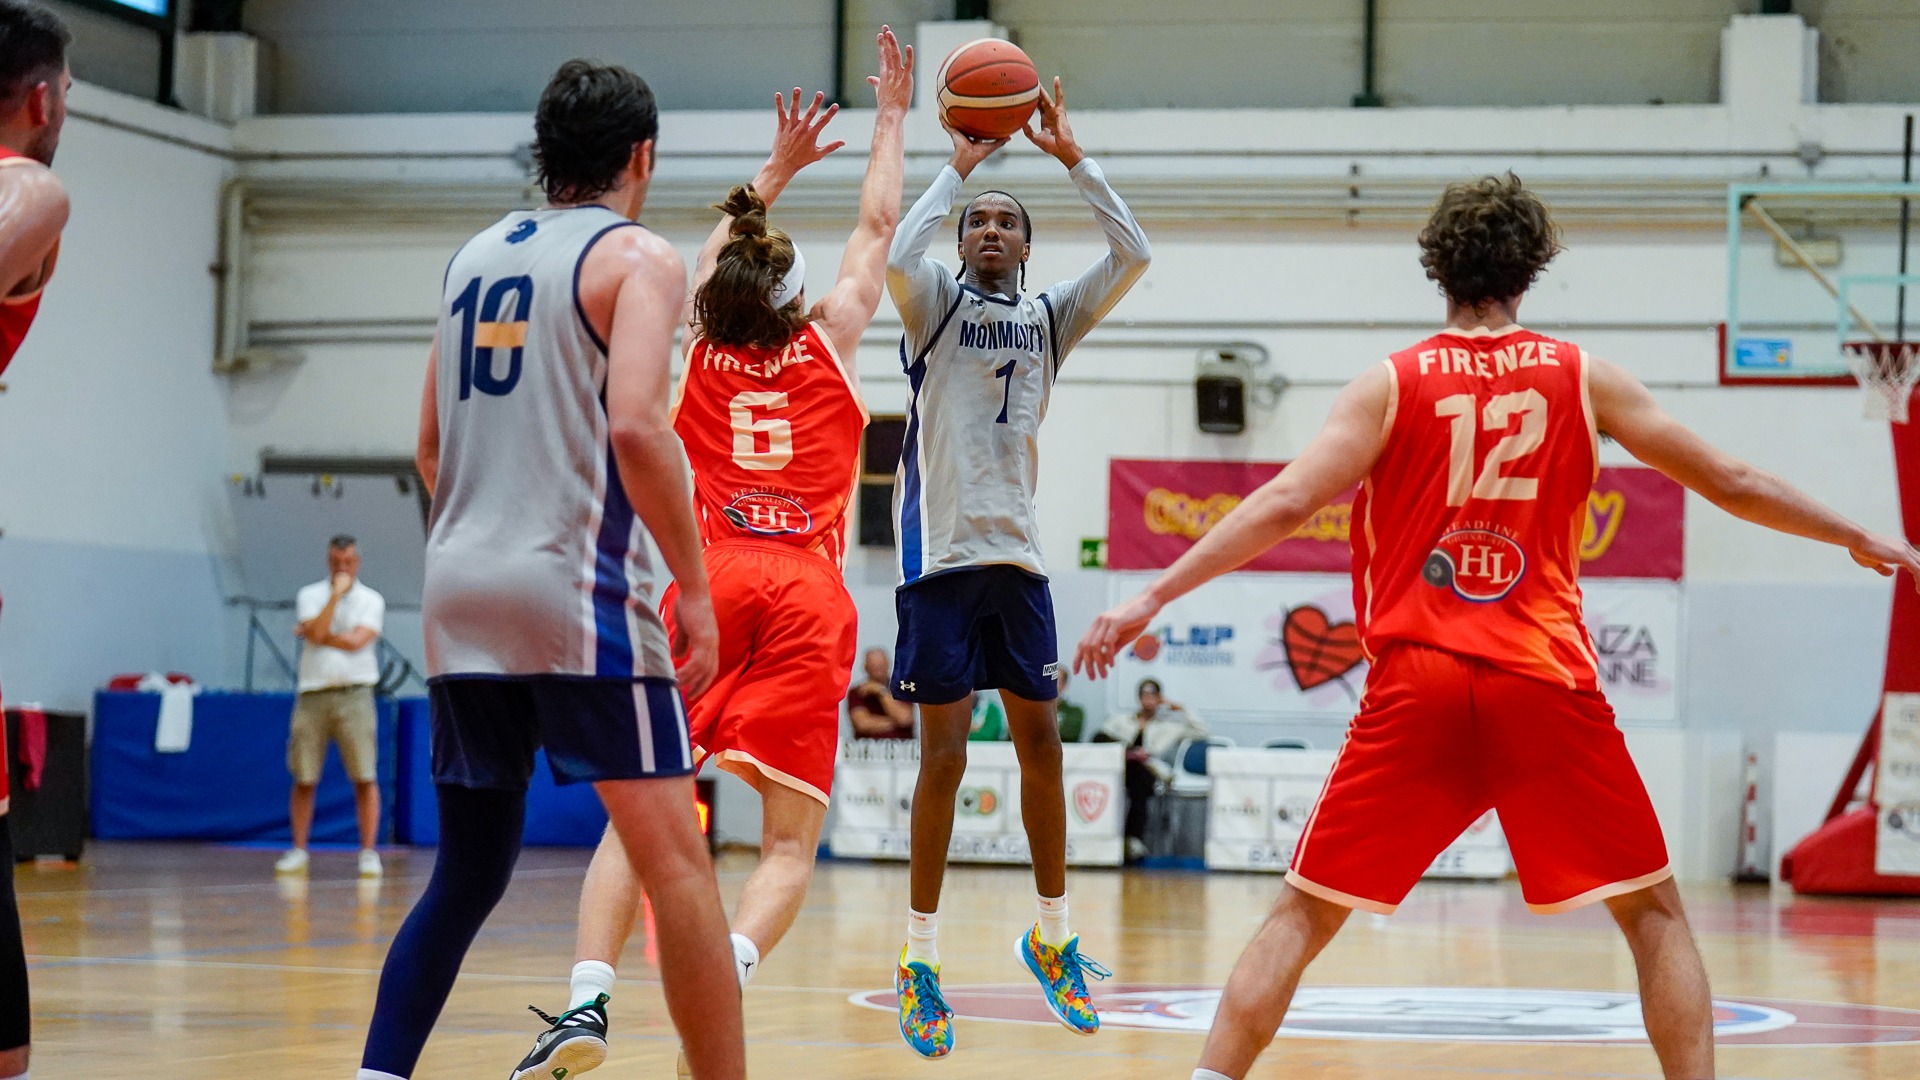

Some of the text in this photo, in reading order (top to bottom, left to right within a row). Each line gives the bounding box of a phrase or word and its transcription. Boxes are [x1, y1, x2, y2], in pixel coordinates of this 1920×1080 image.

[451, 274, 534, 401] 10
[1418, 341, 1560, 378] FIRENZE
[995, 359, 1018, 424] 1
[729, 391, 793, 471] 6
[1435, 387, 1548, 507] 12
[730, 485, 804, 505] HEADLINE
[748, 504, 801, 533] HL
[1457, 544, 1513, 584] HL
